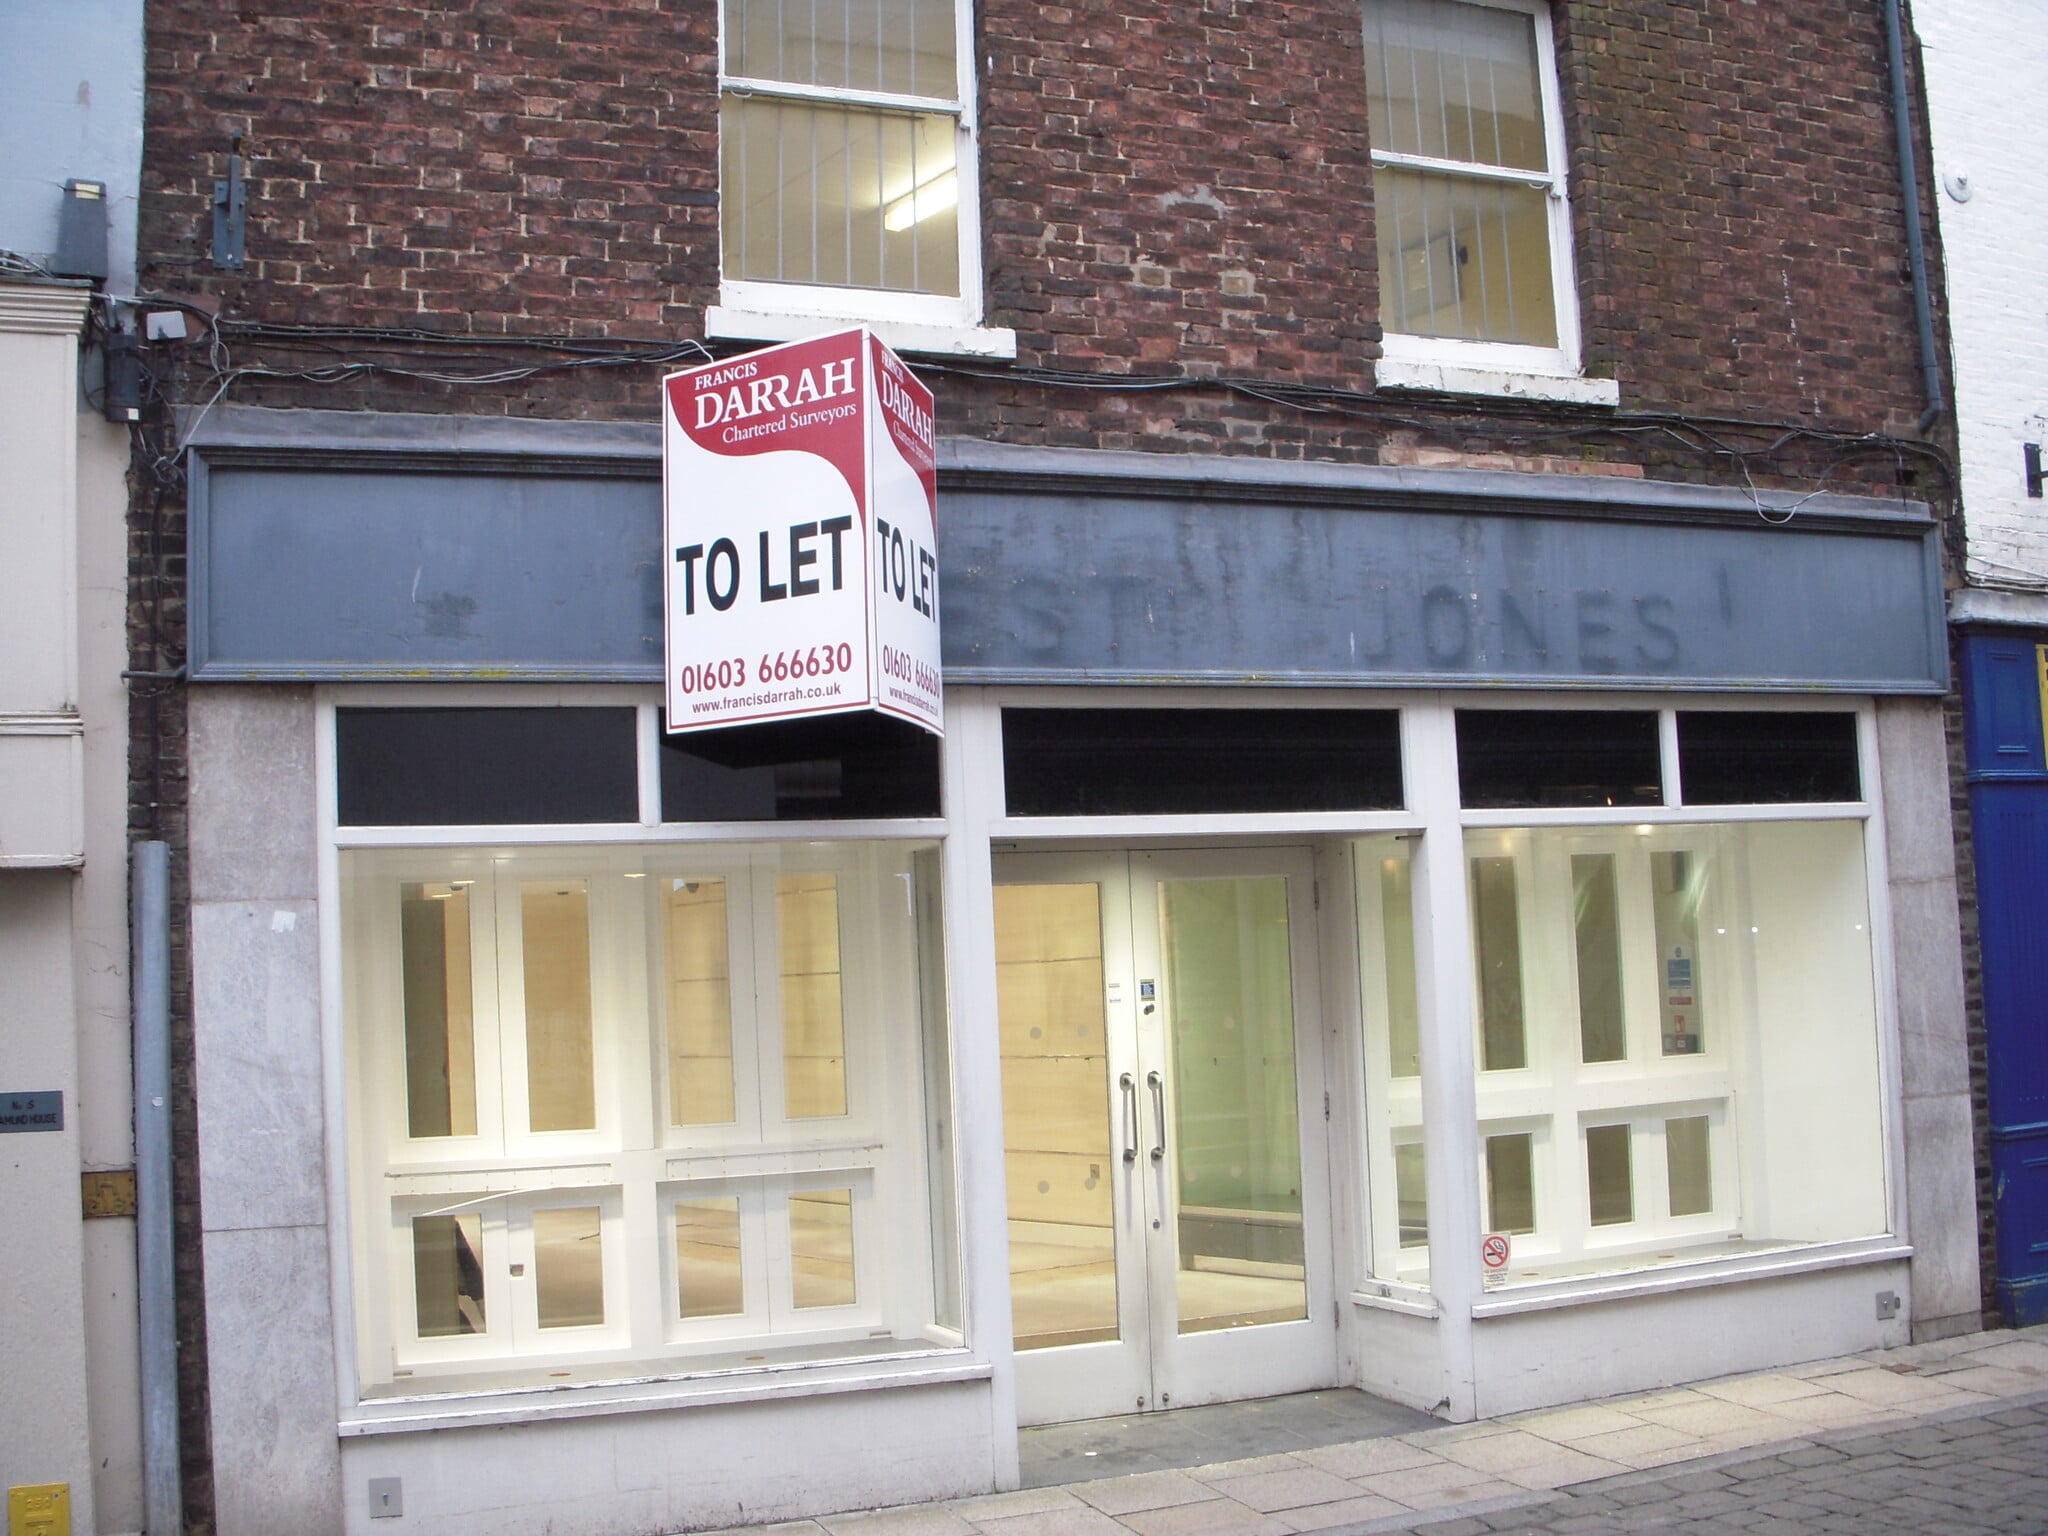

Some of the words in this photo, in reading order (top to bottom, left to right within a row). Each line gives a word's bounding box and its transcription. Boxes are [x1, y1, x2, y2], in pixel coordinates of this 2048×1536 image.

[694, 361, 758, 391] FRANCIS
[694, 357, 857, 430] DARRAH
[722, 414, 787, 444] Chartered
[790, 403, 857, 428] Surveyors
[881, 369, 933, 450] DARRAH
[676, 537, 740, 616] TO
[759, 515, 852, 603] LET
[877, 517, 906, 603] TO
[910, 538, 936, 623] LET
[681, 657, 746, 694] 01603
[758, 642, 852, 683] 666630
[883, 644, 911, 683] 01603
[916, 659, 940, 699] 666630
[692, 682, 841, 714] www.francisdarrah.co.uk
